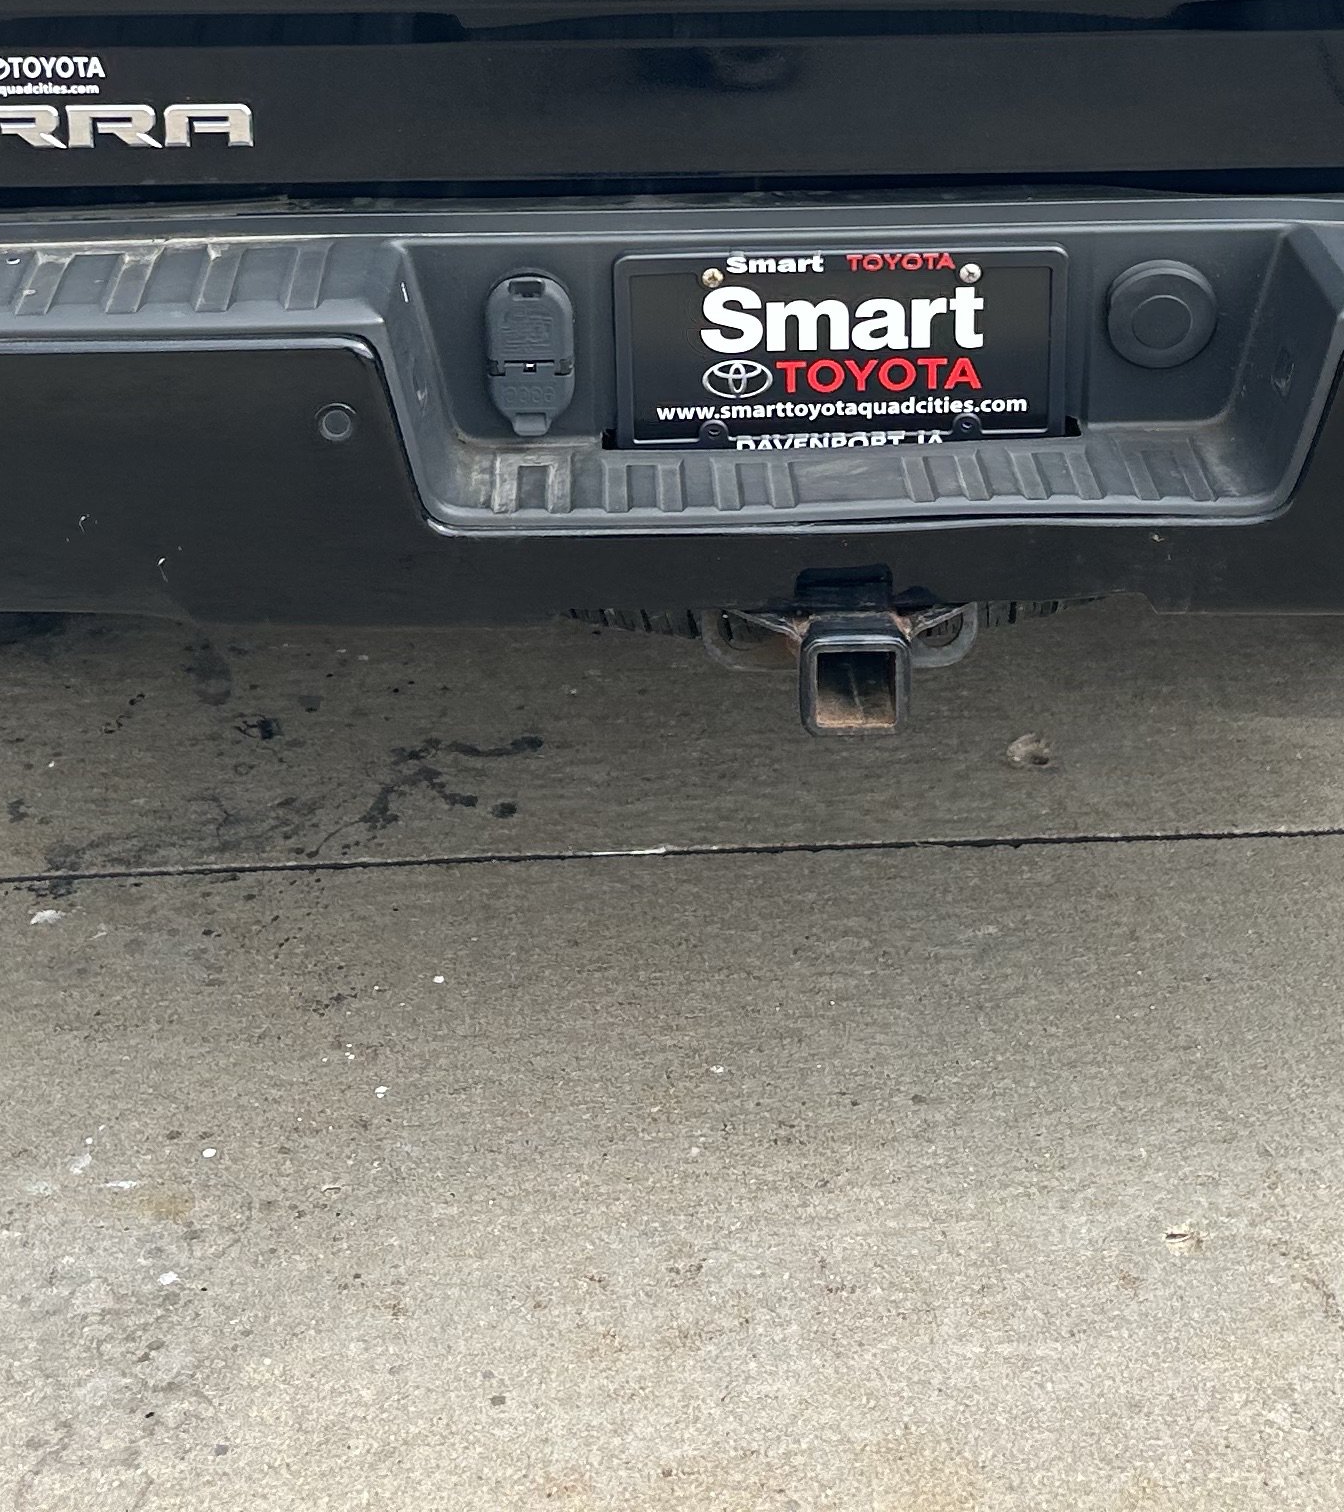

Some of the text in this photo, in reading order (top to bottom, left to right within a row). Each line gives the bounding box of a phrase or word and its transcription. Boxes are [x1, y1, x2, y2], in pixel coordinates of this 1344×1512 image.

[7, 55, 106, 80] TOYOTA
[726, 252, 956, 274] Smart TOYOTA
[700, 285, 984, 354] Smart
[776, 357, 982, 394] TOYOTA
[656, 395, 1029, 422] www.smarttoyotaquadcities.com
